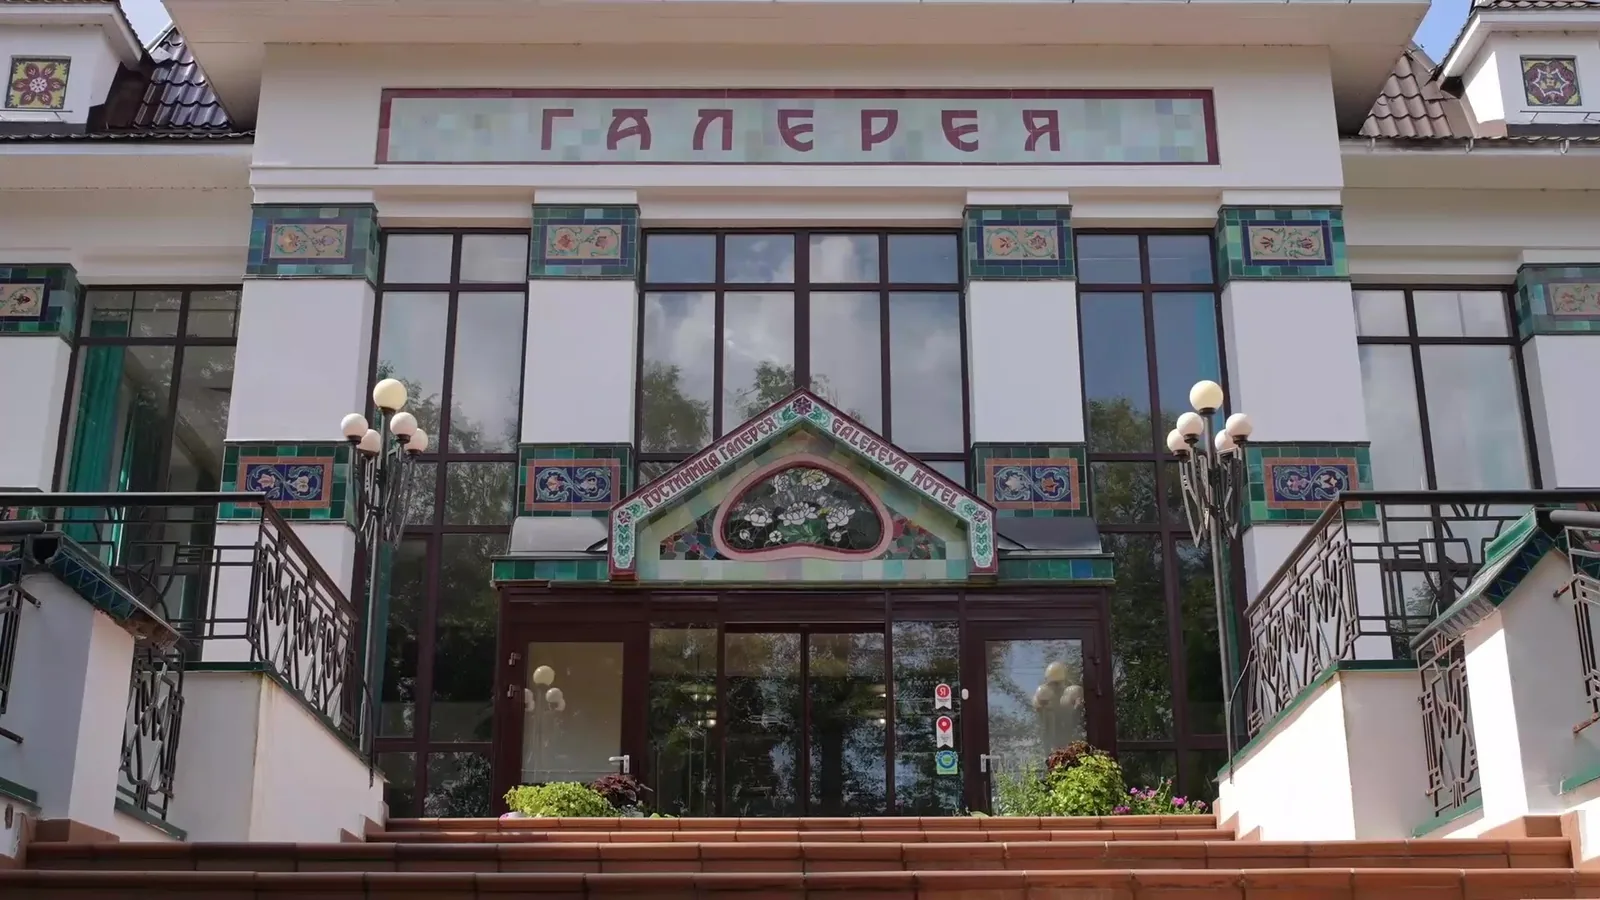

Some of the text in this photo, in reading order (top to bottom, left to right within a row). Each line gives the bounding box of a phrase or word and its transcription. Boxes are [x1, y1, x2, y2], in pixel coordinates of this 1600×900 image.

[541, 108, 1062, 152] ГАЛЕРЕЯ
[642, 416, 778, 509] ГОСТИНИЦА ГАЛЕРЕЯ
[831, 418, 959, 509] GALEREYA HOTEL
